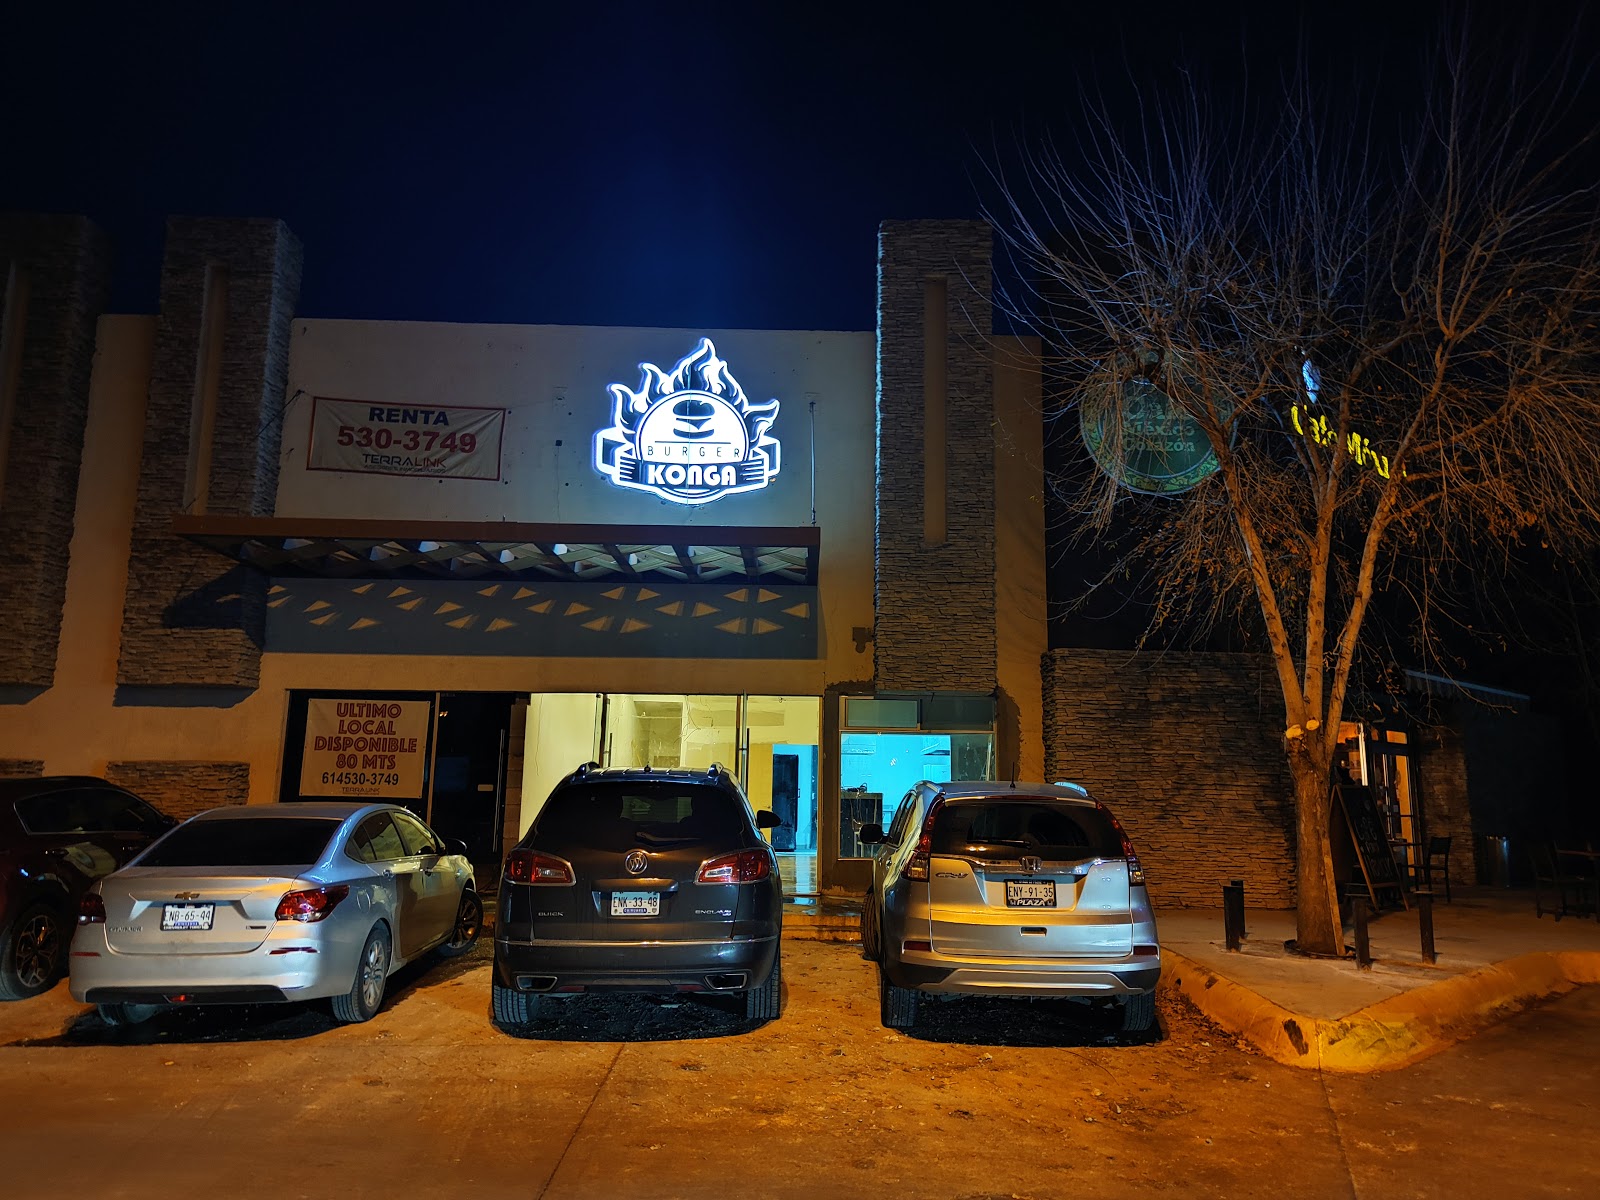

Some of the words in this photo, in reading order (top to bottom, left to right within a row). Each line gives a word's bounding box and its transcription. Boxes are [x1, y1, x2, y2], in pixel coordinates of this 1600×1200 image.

[368, 407, 449, 426] RENTA
[337, 425, 477, 454] 530-3749
[647, 445, 740, 458] BURGER
[362, 453, 447, 468] TERRALINK
[647, 464, 737, 486] KONGA
[336, 702, 402, 719] ULTIMO
[338, 720, 396, 735] LOCAL
[314, 736, 418, 753] DISPONIBLE
[336, 753, 358, 769] 80
[362, 754, 396, 770] MTS
[321, 771, 399, 786] 614530-3749
[1008, 886, 1053, 898] ENY-91-35
[613, 896, 658, 908] ENK-33-48
